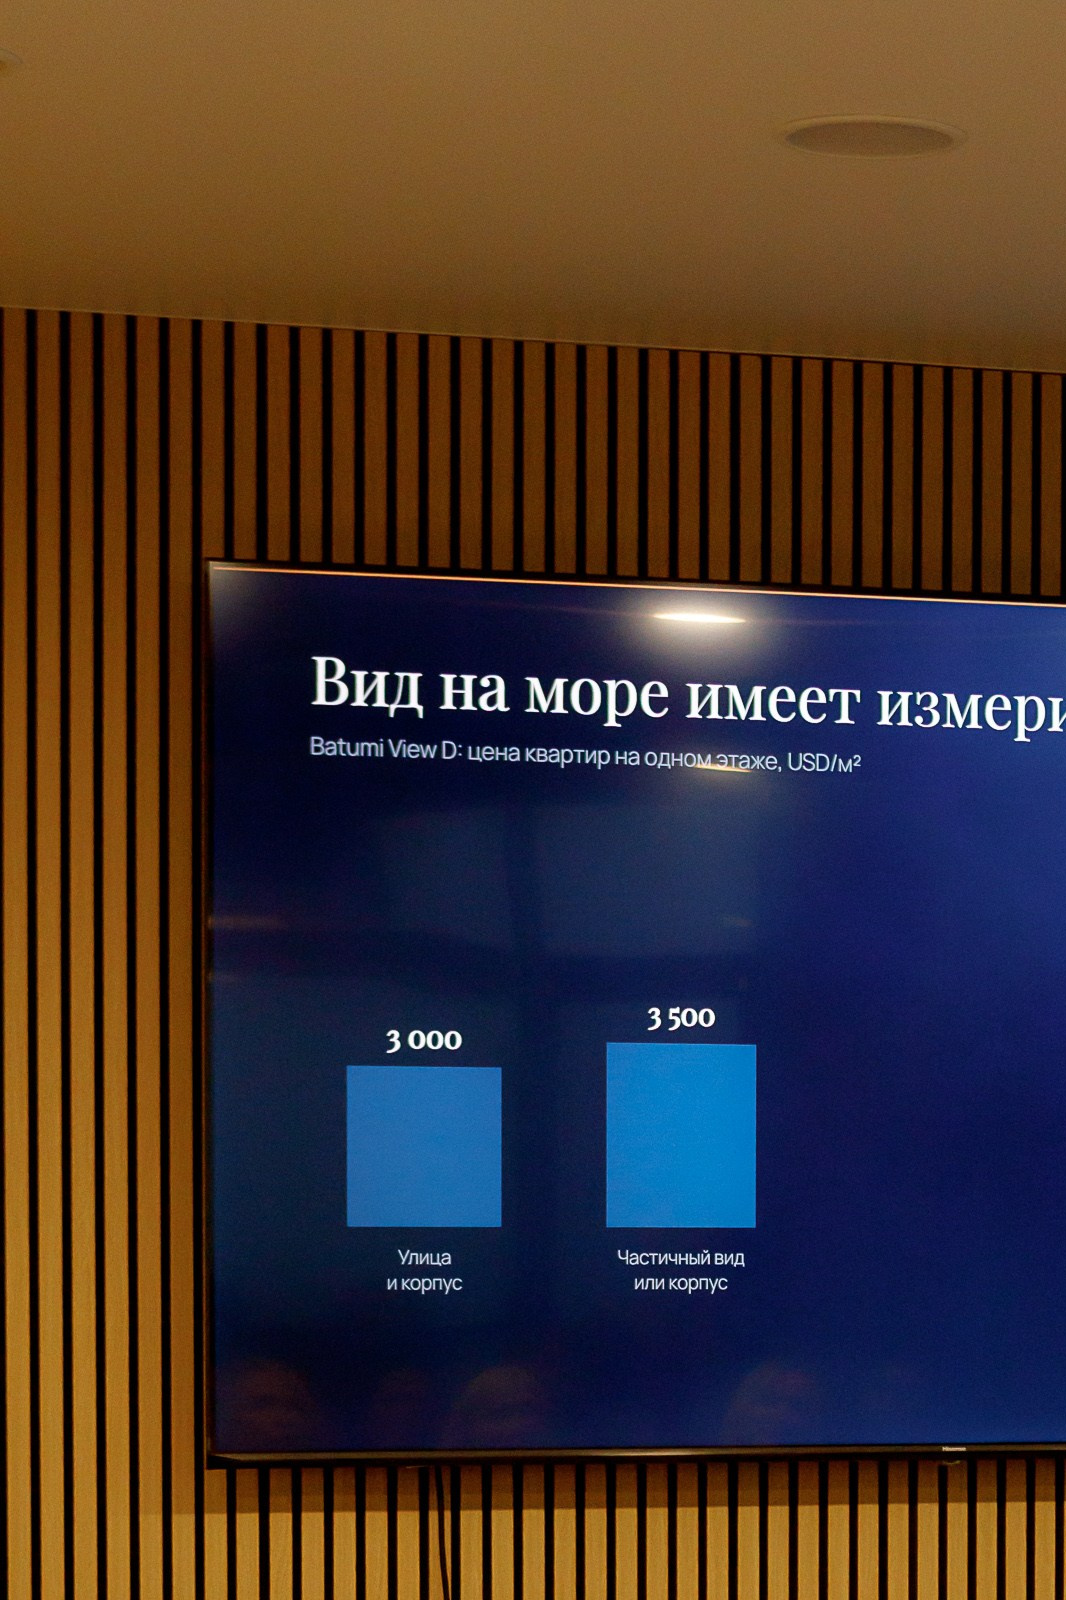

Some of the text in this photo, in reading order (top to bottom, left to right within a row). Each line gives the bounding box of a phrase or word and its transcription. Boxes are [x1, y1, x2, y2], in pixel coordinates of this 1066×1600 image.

[311, 656, 424, 719] Вид
[439, 674, 511, 713] на
[524, 677, 669, 728] море
[685, 683, 861, 725] имеет
[310, 736, 384, 757] Batumi
[388, 739, 438, 759] View
[442, 740, 463, 760] D:
[468, 746, 521, 763] цена
[525, 747, 611, 770] квартир
[615, 750, 640, 766] на
[644, 751, 712, 769] одном
[716, 753, 782, 773] этаже,
[647, 1006, 716, 1031] 3 500
[386, 1029, 463, 1054] 3 000
[397, 1249, 452, 1267] Улица
[617, 1249, 746, 1268] Частичный вид
[387, 1277, 463, 1295] и корпус
[634, 1277, 728, 1295] или корпус
